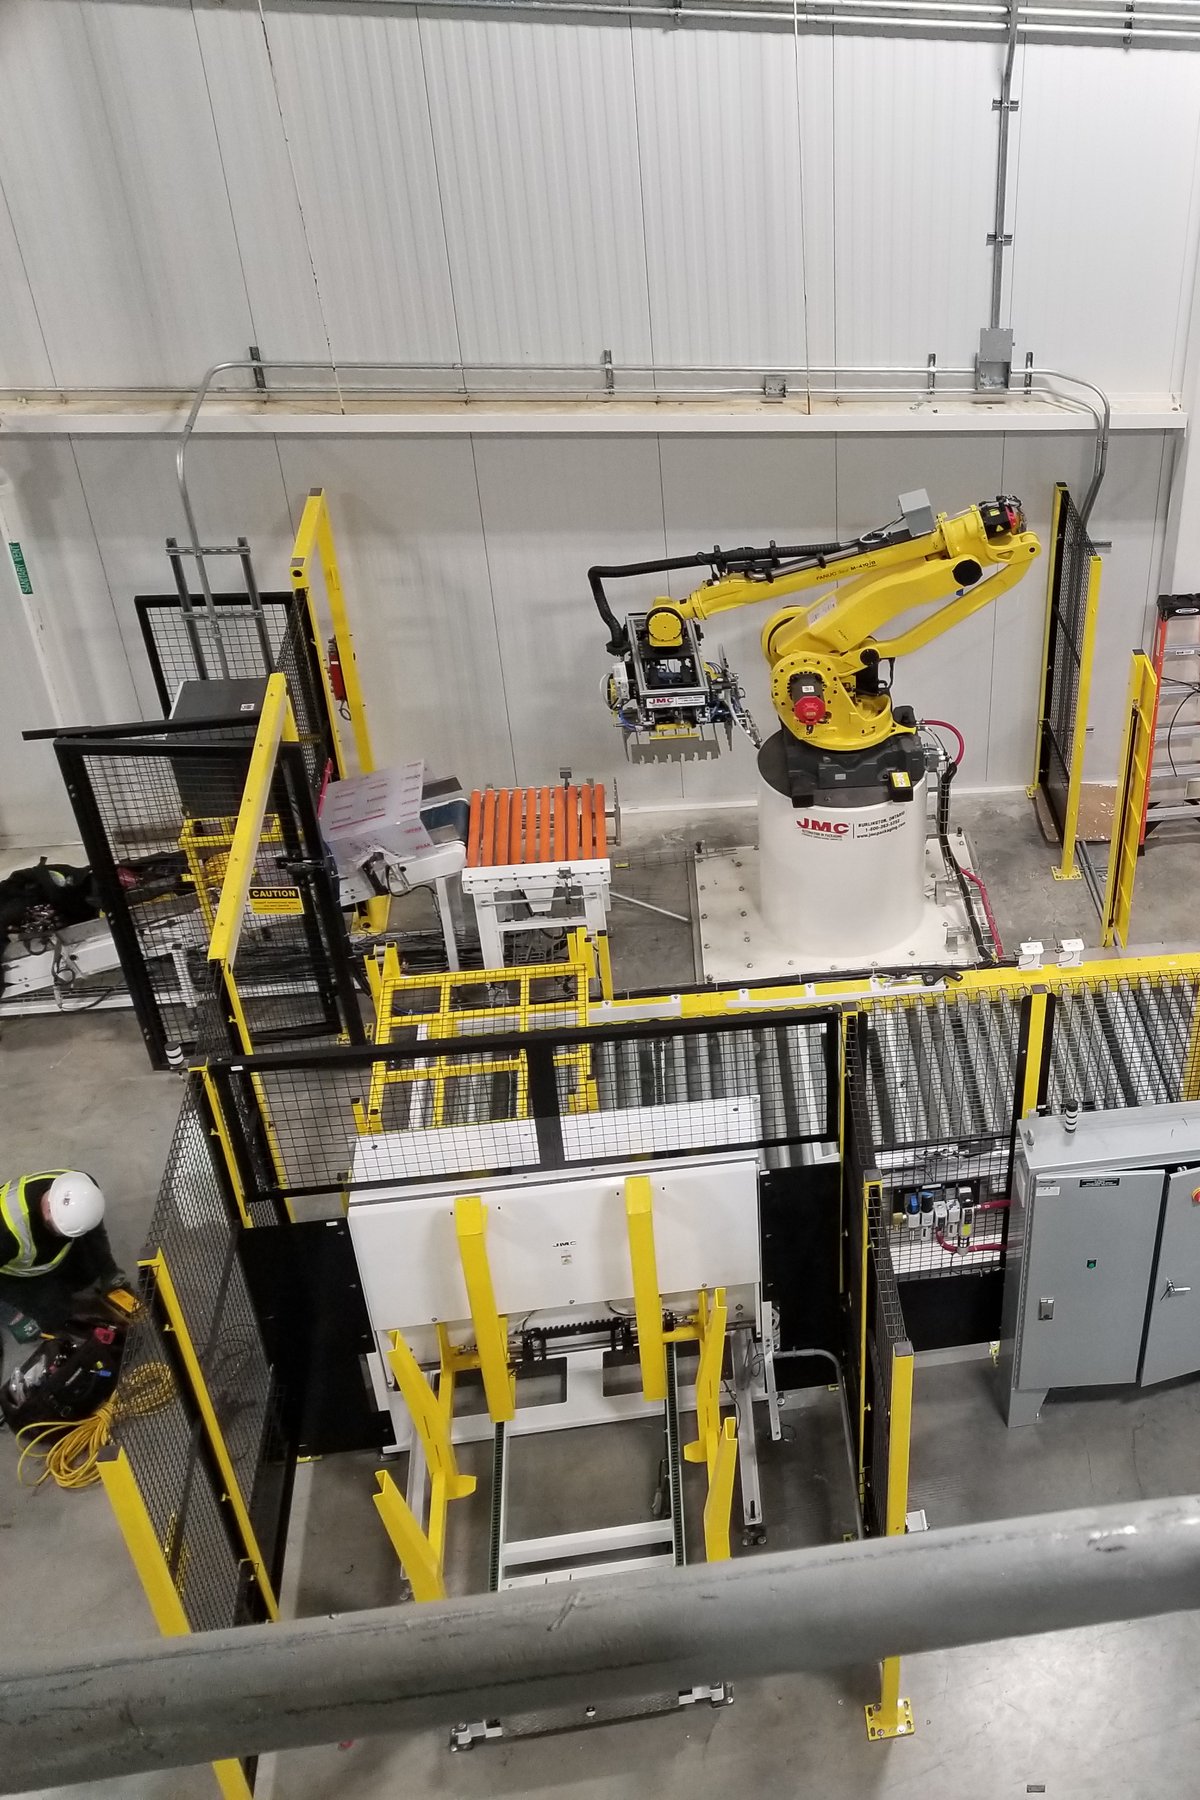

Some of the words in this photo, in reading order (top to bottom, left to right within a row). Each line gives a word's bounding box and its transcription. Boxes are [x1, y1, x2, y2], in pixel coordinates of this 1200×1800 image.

[796, 817, 849, 834] JMC
[252, 890, 296, 898] CAUTION
[552, 1240, 577, 1248] JMC
